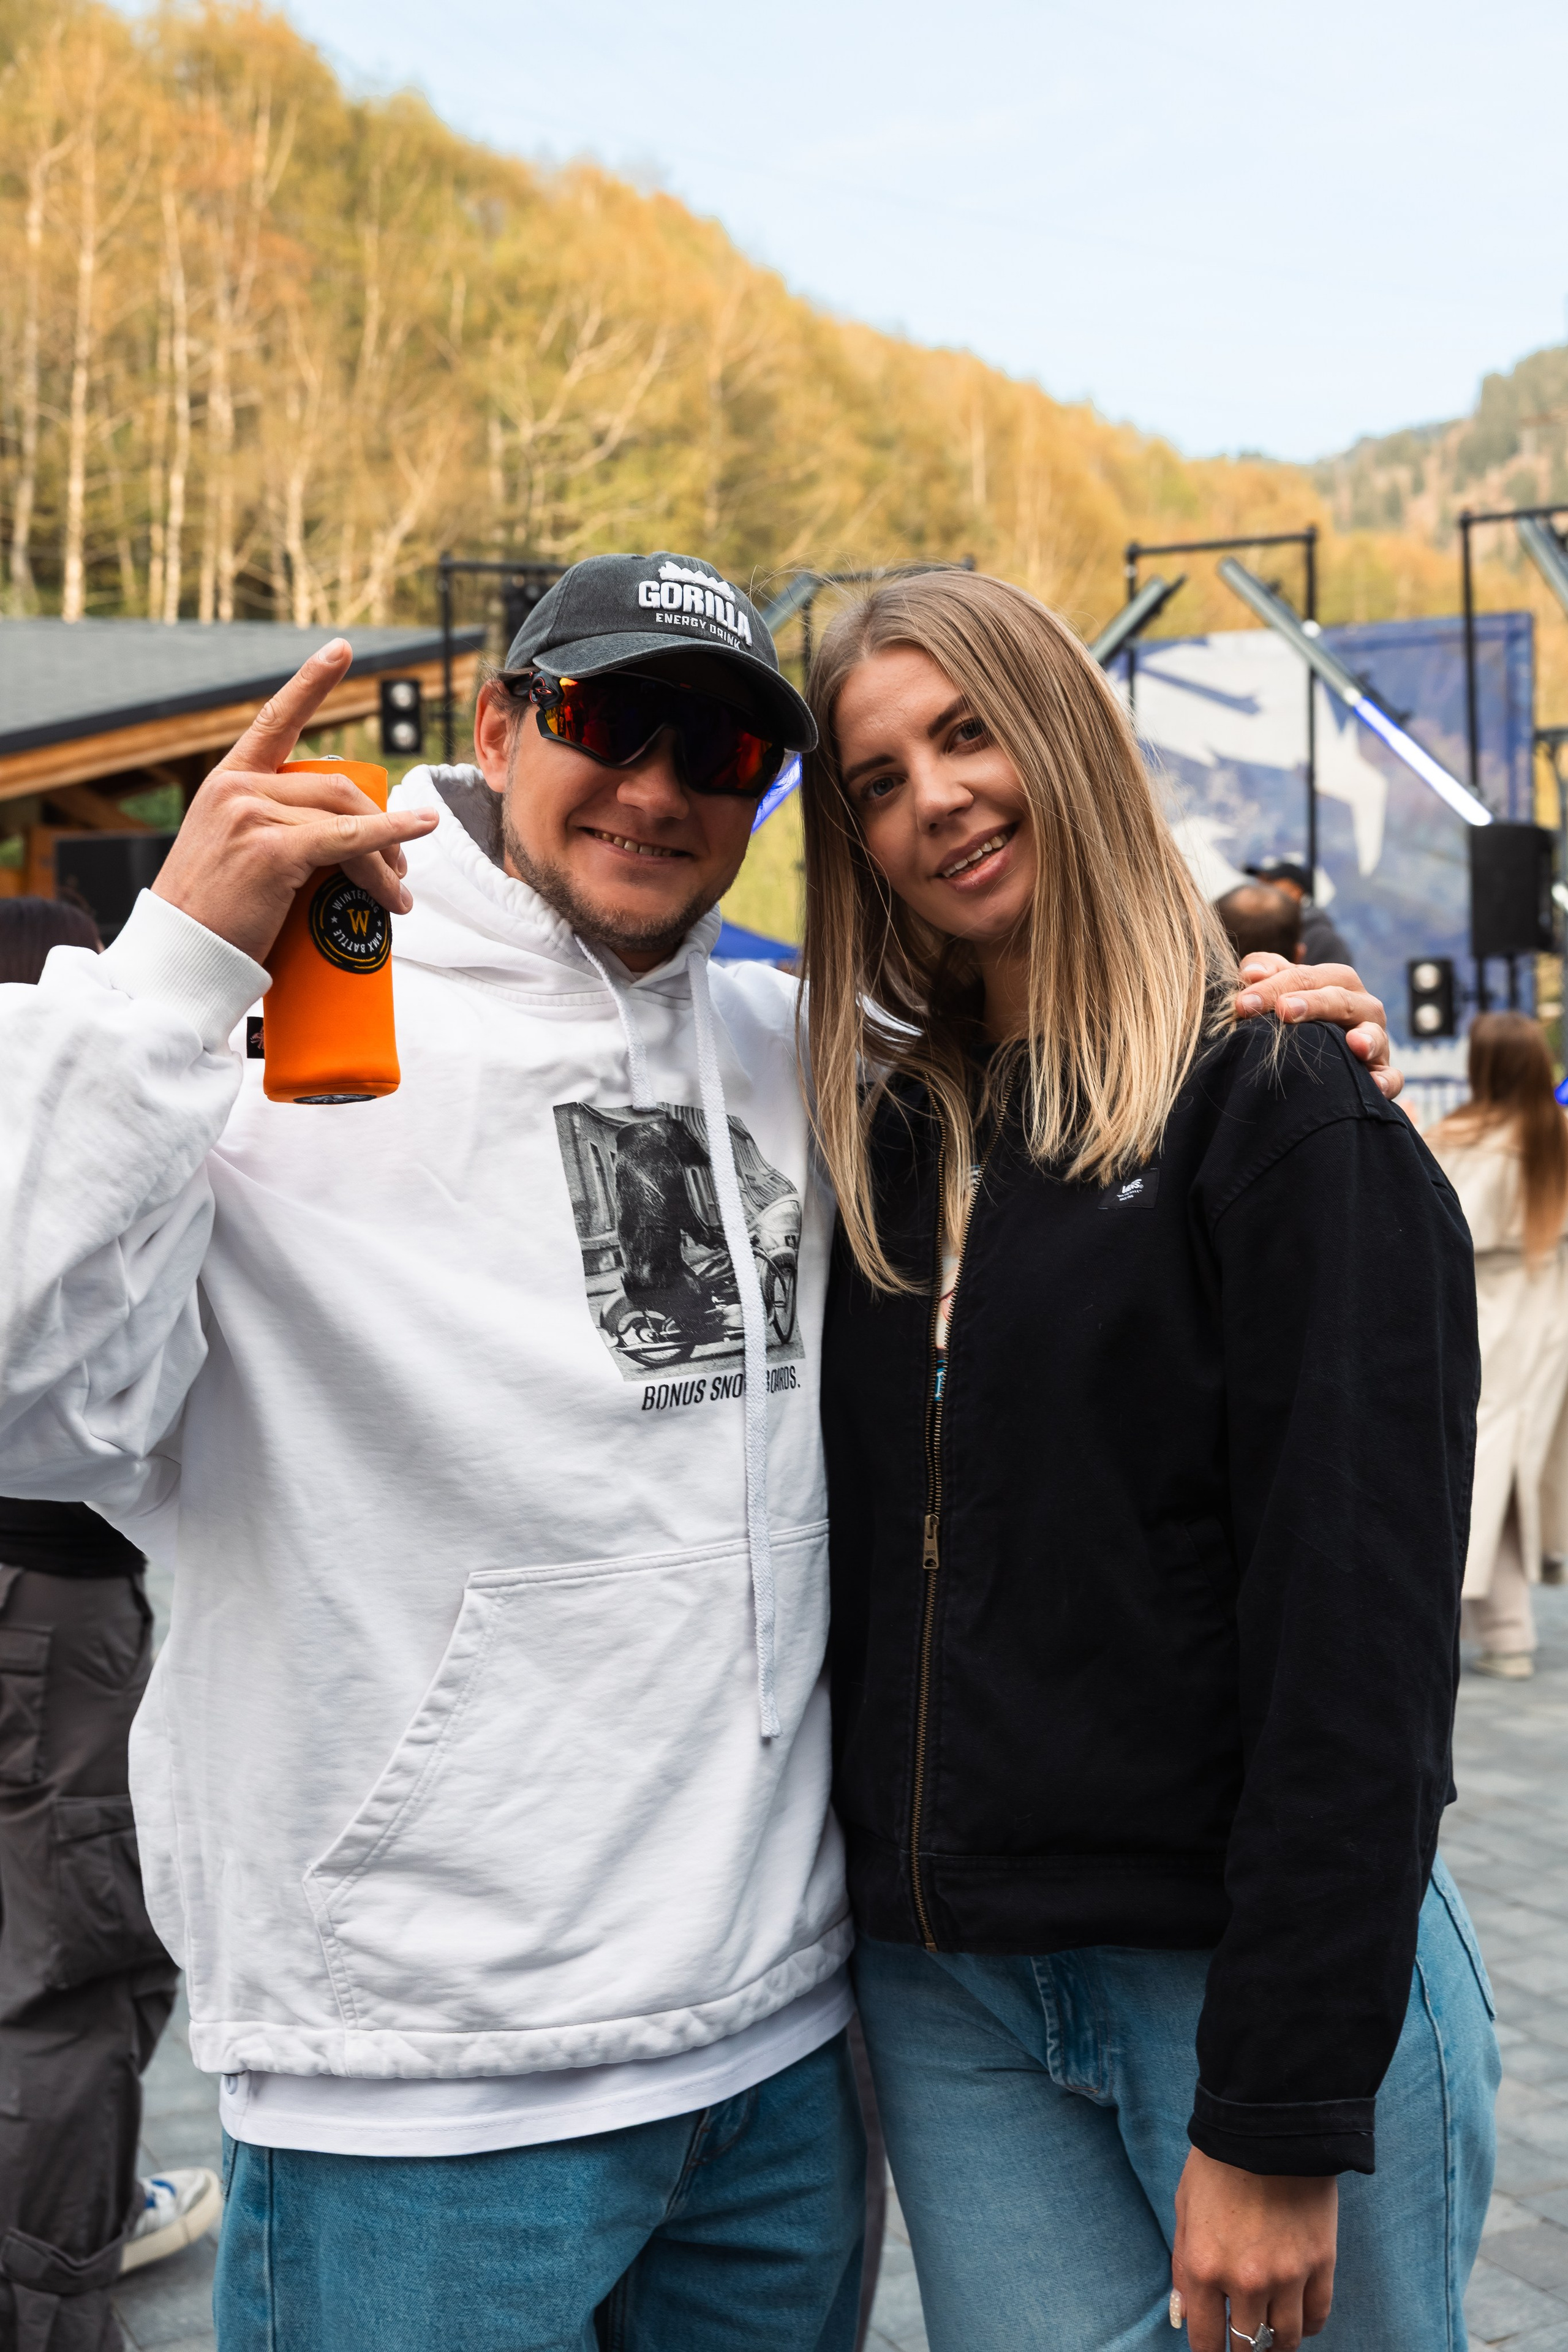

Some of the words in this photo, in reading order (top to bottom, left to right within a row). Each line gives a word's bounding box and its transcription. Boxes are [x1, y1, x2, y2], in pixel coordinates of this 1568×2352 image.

[638, 581, 752, 647] GORILLA
[656, 612, 706, 629] ENERGY
[709, 624, 741, 650] DRINK
[333, 890, 379, 913] WINTERING
[347, 909, 369, 936] W
[334, 929, 366, 953] BATTLE
[368, 932, 382, 952] BMX
[641, 1379, 706, 1411] BONUS
[710, 1365, 801, 1400] SNOOARDS.
